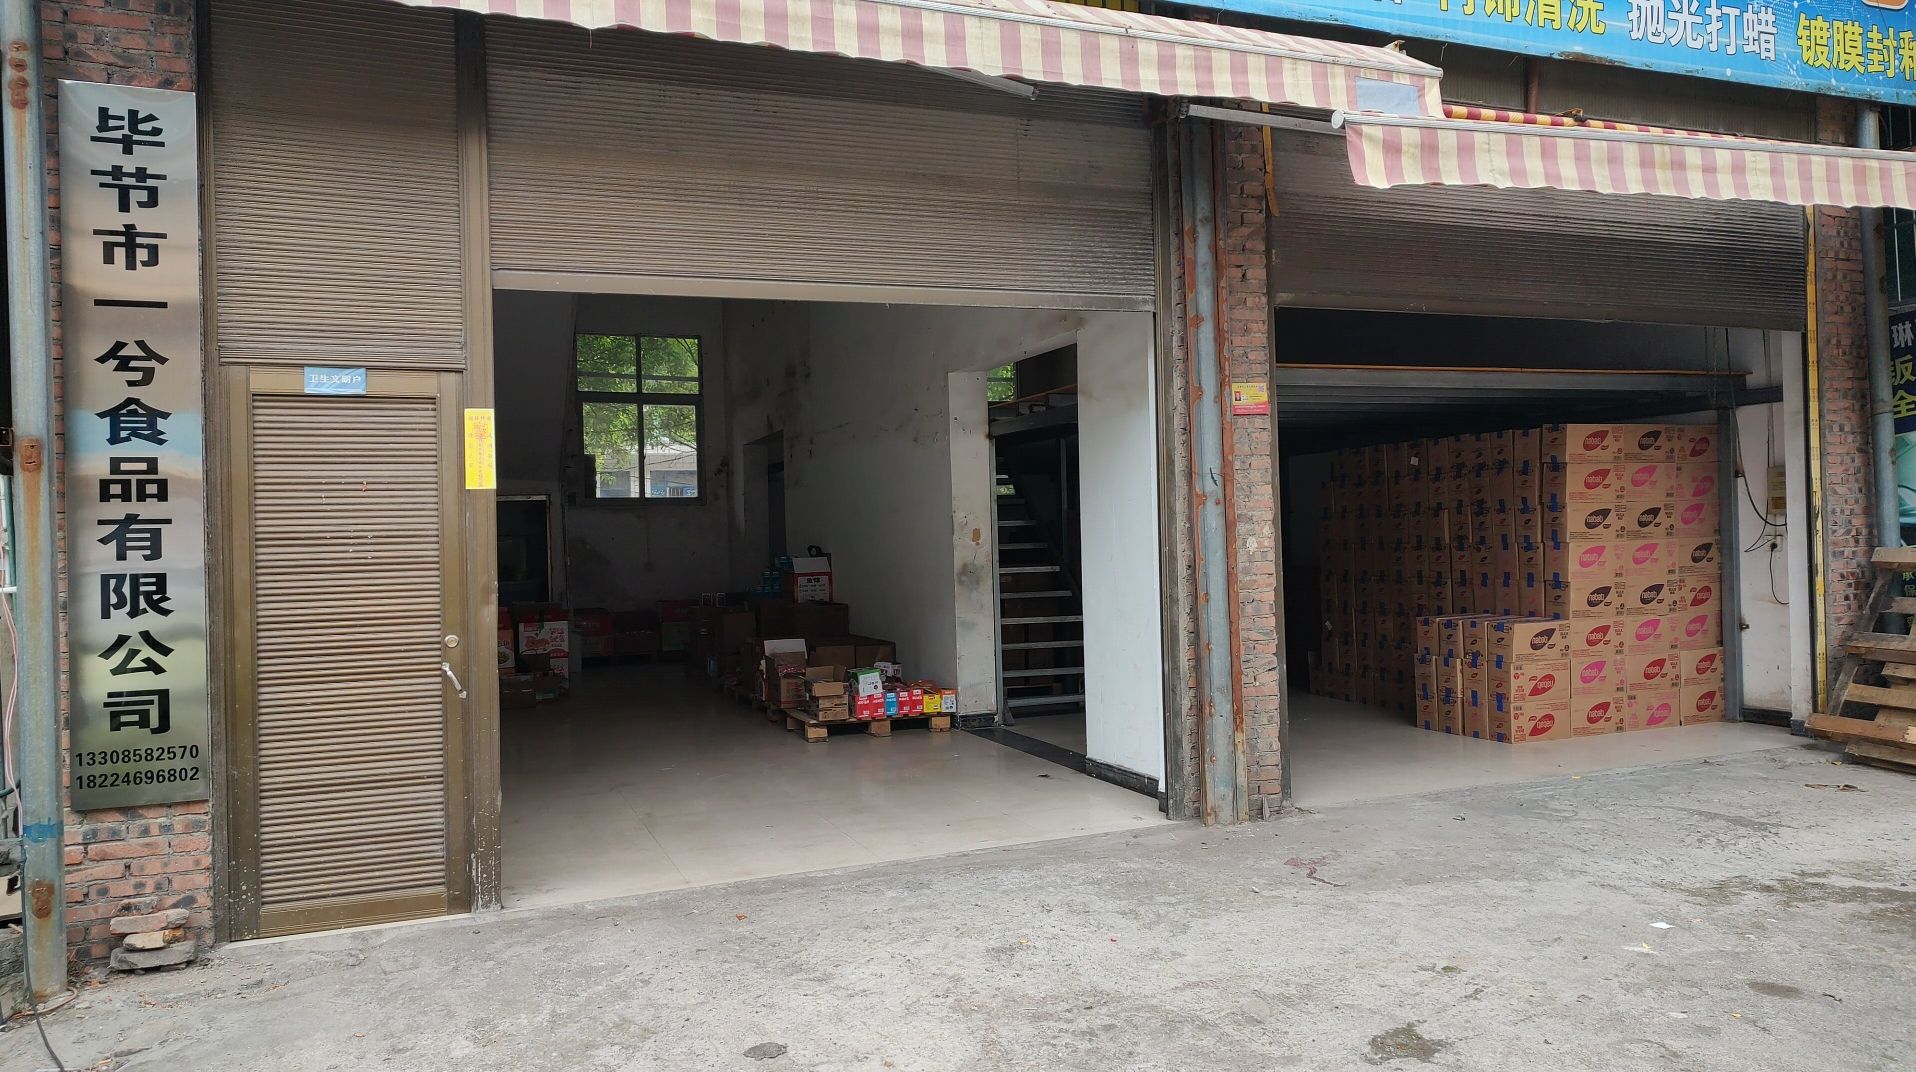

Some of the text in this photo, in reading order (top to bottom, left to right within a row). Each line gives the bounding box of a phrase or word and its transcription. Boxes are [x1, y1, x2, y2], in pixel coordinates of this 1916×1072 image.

[1439, 0, 1606, 34] 清洗
[1628, 0, 1778, 60] 抛光打蜡
[309, 374, 361, 384] 卫生文明户
[90, 106, 174, 735] 毕节市一兮食品有限公司
[75, 744, 199, 767] 13308582570
[75, 766, 200, 789] 18224696802
